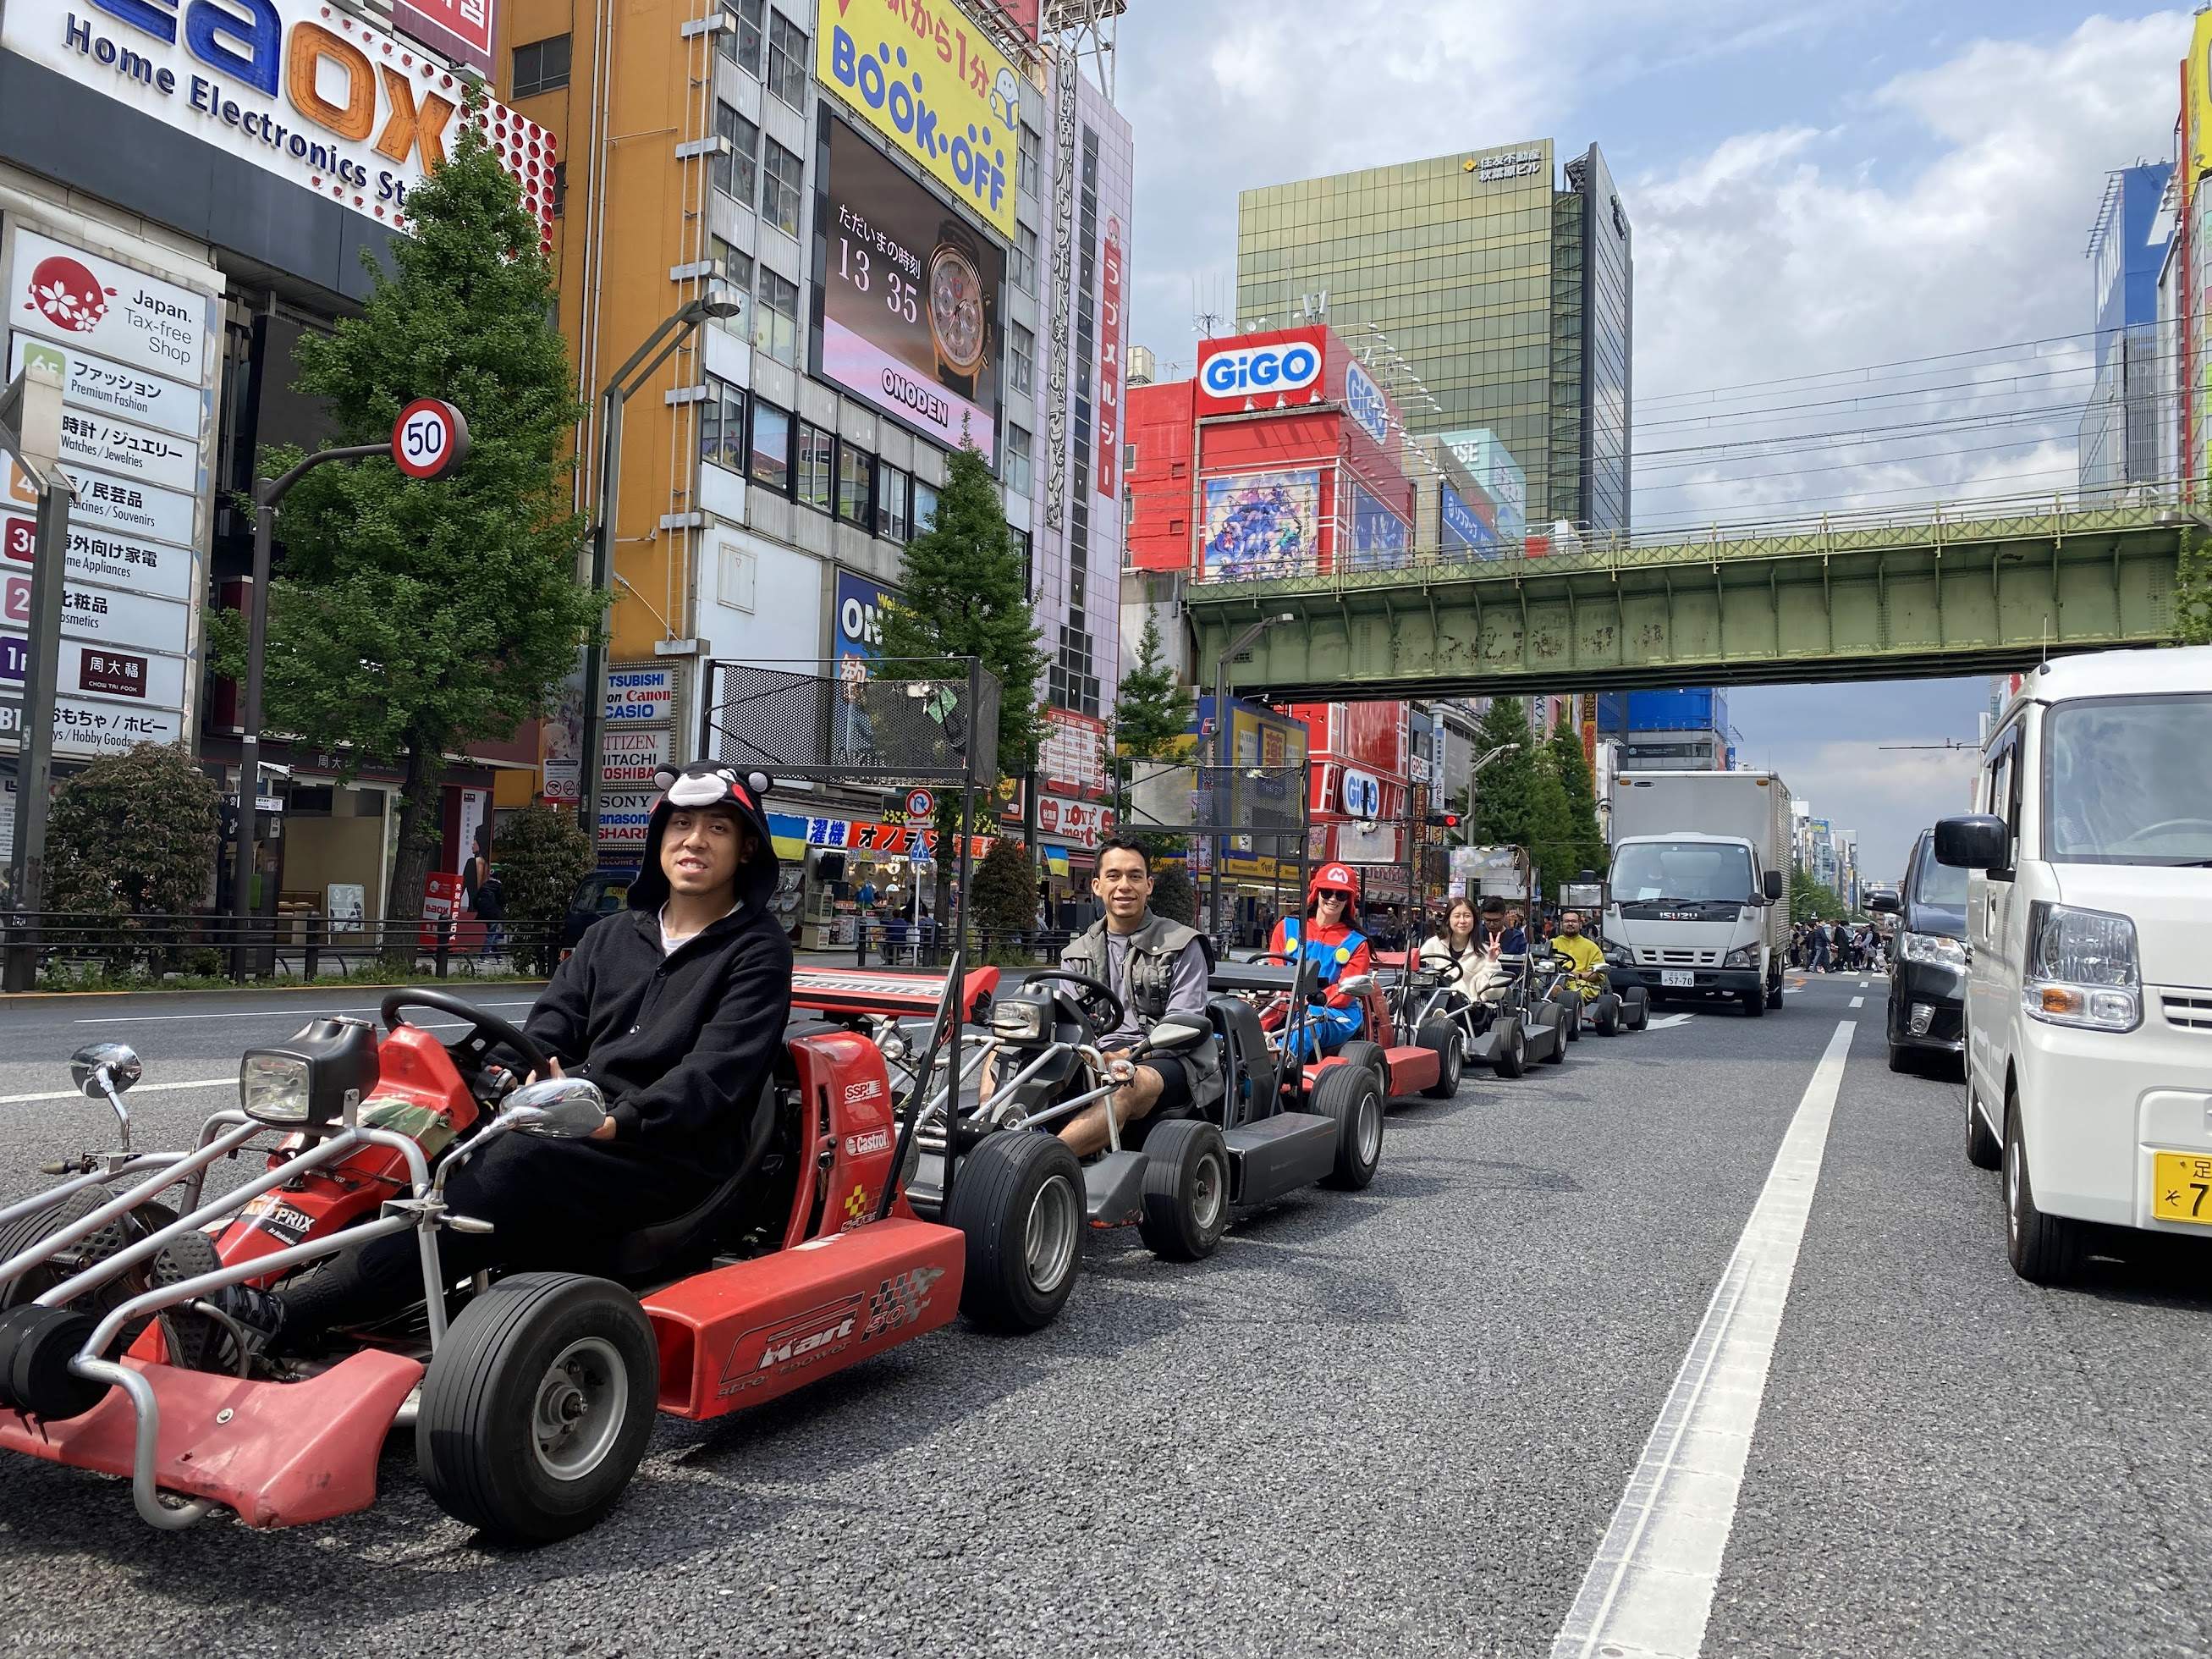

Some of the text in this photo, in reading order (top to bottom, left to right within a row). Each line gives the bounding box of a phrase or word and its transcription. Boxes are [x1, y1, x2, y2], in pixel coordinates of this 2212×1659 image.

[64, 12, 176, 95] Home
[188, 74, 366, 189] Electronics
[839, 204, 921, 280] ただいまの時刻
[839, 237, 918, 324] 13 35
[133, 289, 192, 323] Japan.
[124, 306, 192, 344] Tax-free
[148, 336, 190, 366] Shop
[73, 361, 162, 399] ファッション
[1100, 257, 1120, 486] ラブメルシー
[1207, 348, 1315, 391] GiGO
[71, 380, 148, 413] Premium Fashion
[881, 368, 948, 427] ONODEN
[62, 416, 96, 440] 時計
[113, 430, 183, 459] ジュエリー
[408, 420, 441, 456] 50
[61, 434, 97, 456] Watches
[104, 448, 143, 468] Jewelries
[92, 482, 143, 509] 民芸品
[113, 505, 155, 526] Souvenirs
[82, 557, 131, 578] Appliances
[14, 587, 30, 612] 2
[60, 614, 99, 628] osmetics
[90, 656, 139, 679] 周大福
[608, 673, 664, 687] TSUBISHI
[88, 681, 107, 689] CHOW
[120, 685, 138, 693] FOOK
[607, 690, 671, 703] on Canon
[73, 729, 102, 747] Hobby
[104, 732, 131, 747] Goods
[124, 716, 168, 734] ホビー
[603, 767, 655, 780] OSHIBA
[1411, 757, 1423, 774] GPS
[600, 796, 651, 808] SONY
[598, 811, 650, 824] anasoni
[808, 818, 846, 846] 濯機
[1659, 912, 1698, 920] ISUZU
[857, 1132, 887, 1152] Castrol
[274, 1207, 316, 1232] PRIX
[759, 1317, 857, 1370] Kart
